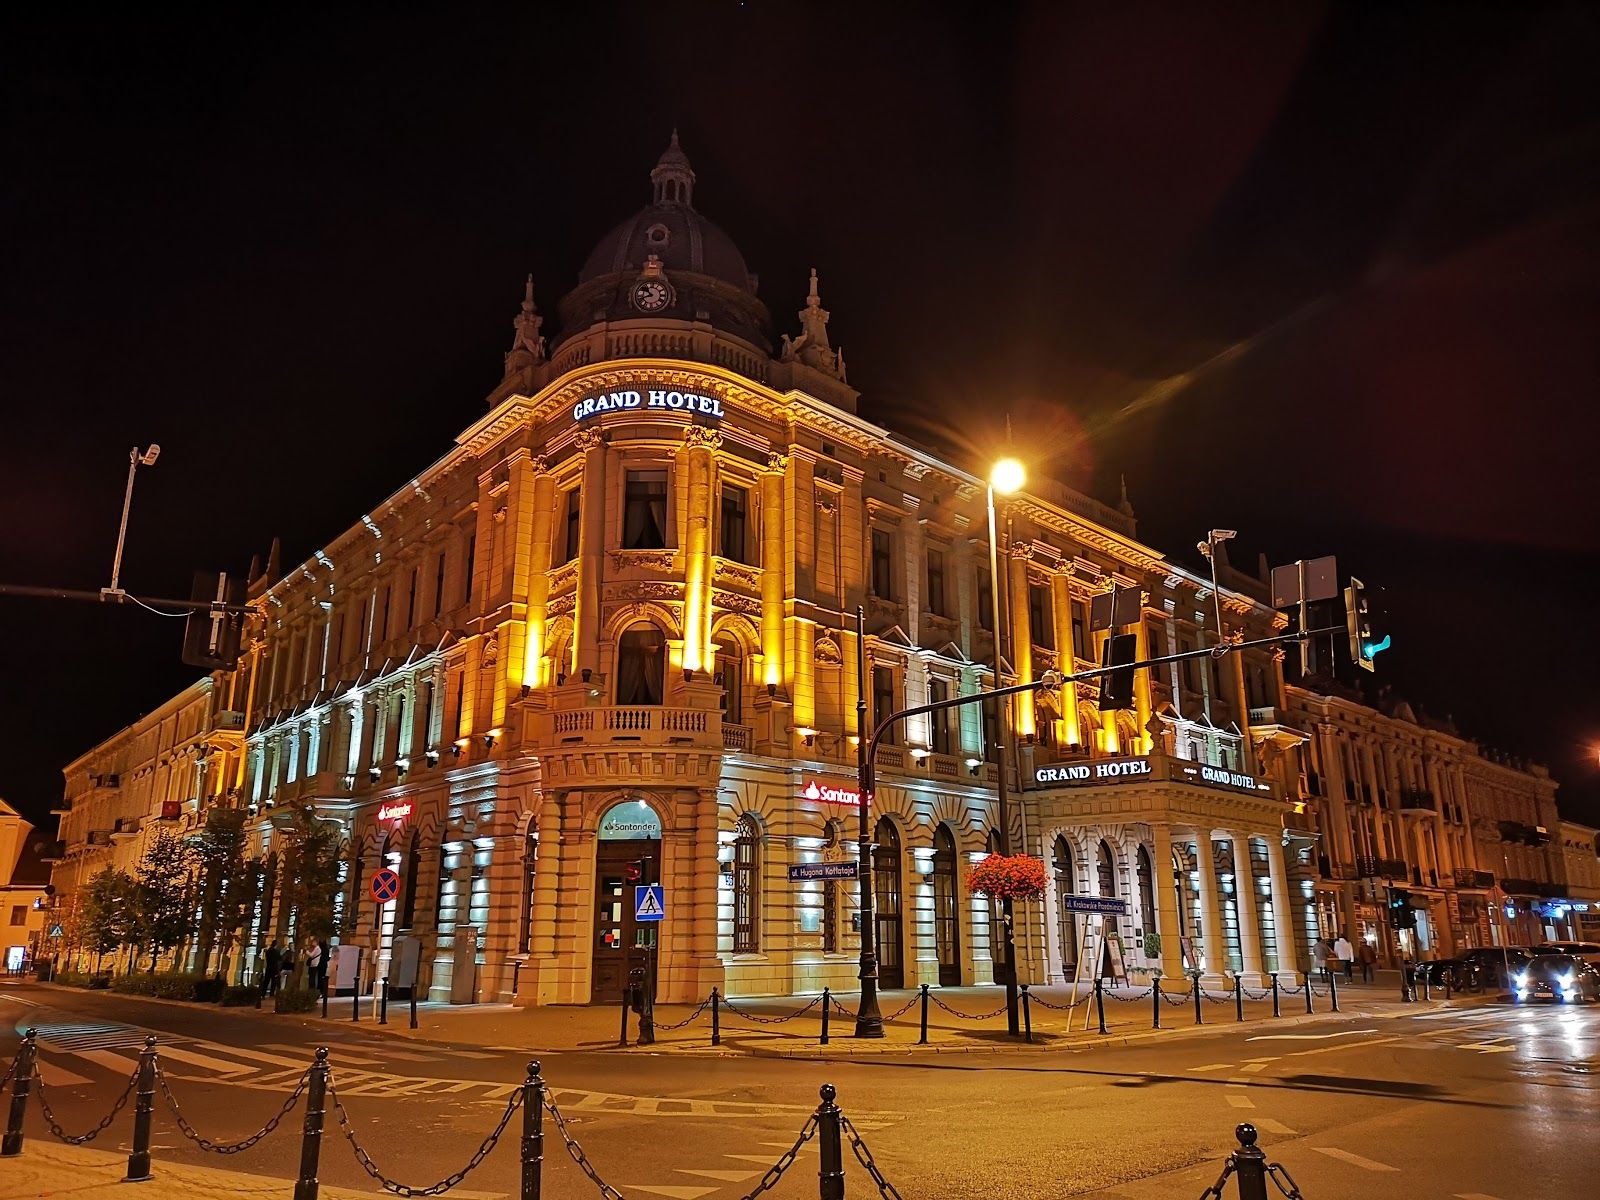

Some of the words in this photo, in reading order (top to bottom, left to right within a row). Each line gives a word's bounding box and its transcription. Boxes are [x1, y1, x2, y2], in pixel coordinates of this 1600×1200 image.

[574, 391, 642, 421] GRAND
[648, 391, 725, 418] HOTEL
[1036, 766, 1091, 782] GRAND
[1095, 760, 1151, 777] HOTEL
[1202, 767, 1230, 784] GRAND
[1230, 773, 1256, 789] HOTEL
[614, 823, 656, 831] Santander
[800, 868, 823, 878] Hugona
